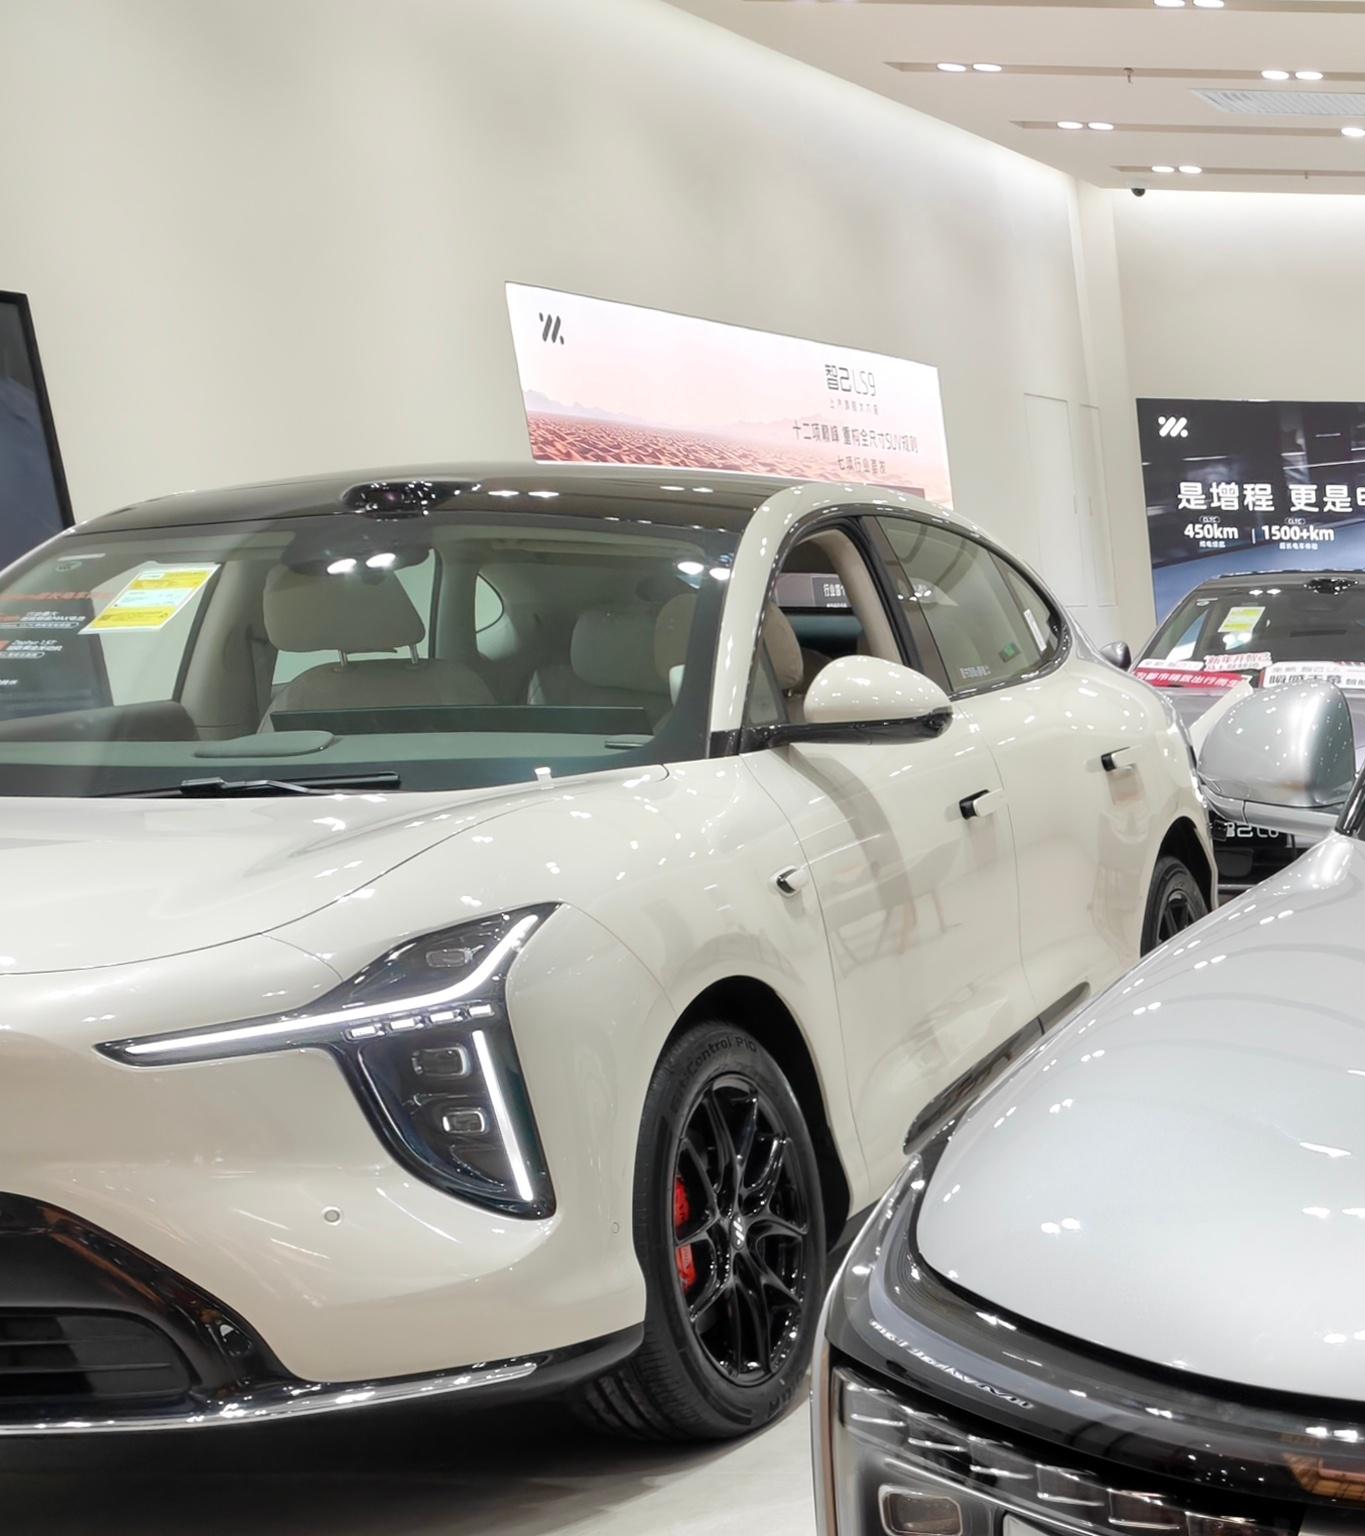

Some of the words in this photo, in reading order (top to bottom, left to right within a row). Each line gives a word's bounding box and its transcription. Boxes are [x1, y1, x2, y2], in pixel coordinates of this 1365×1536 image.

[1177, 481, 1275, 512] 是增程
[1183, 523, 1239, 541] 450km
[1261, 524, 1335, 542] 1500+km
